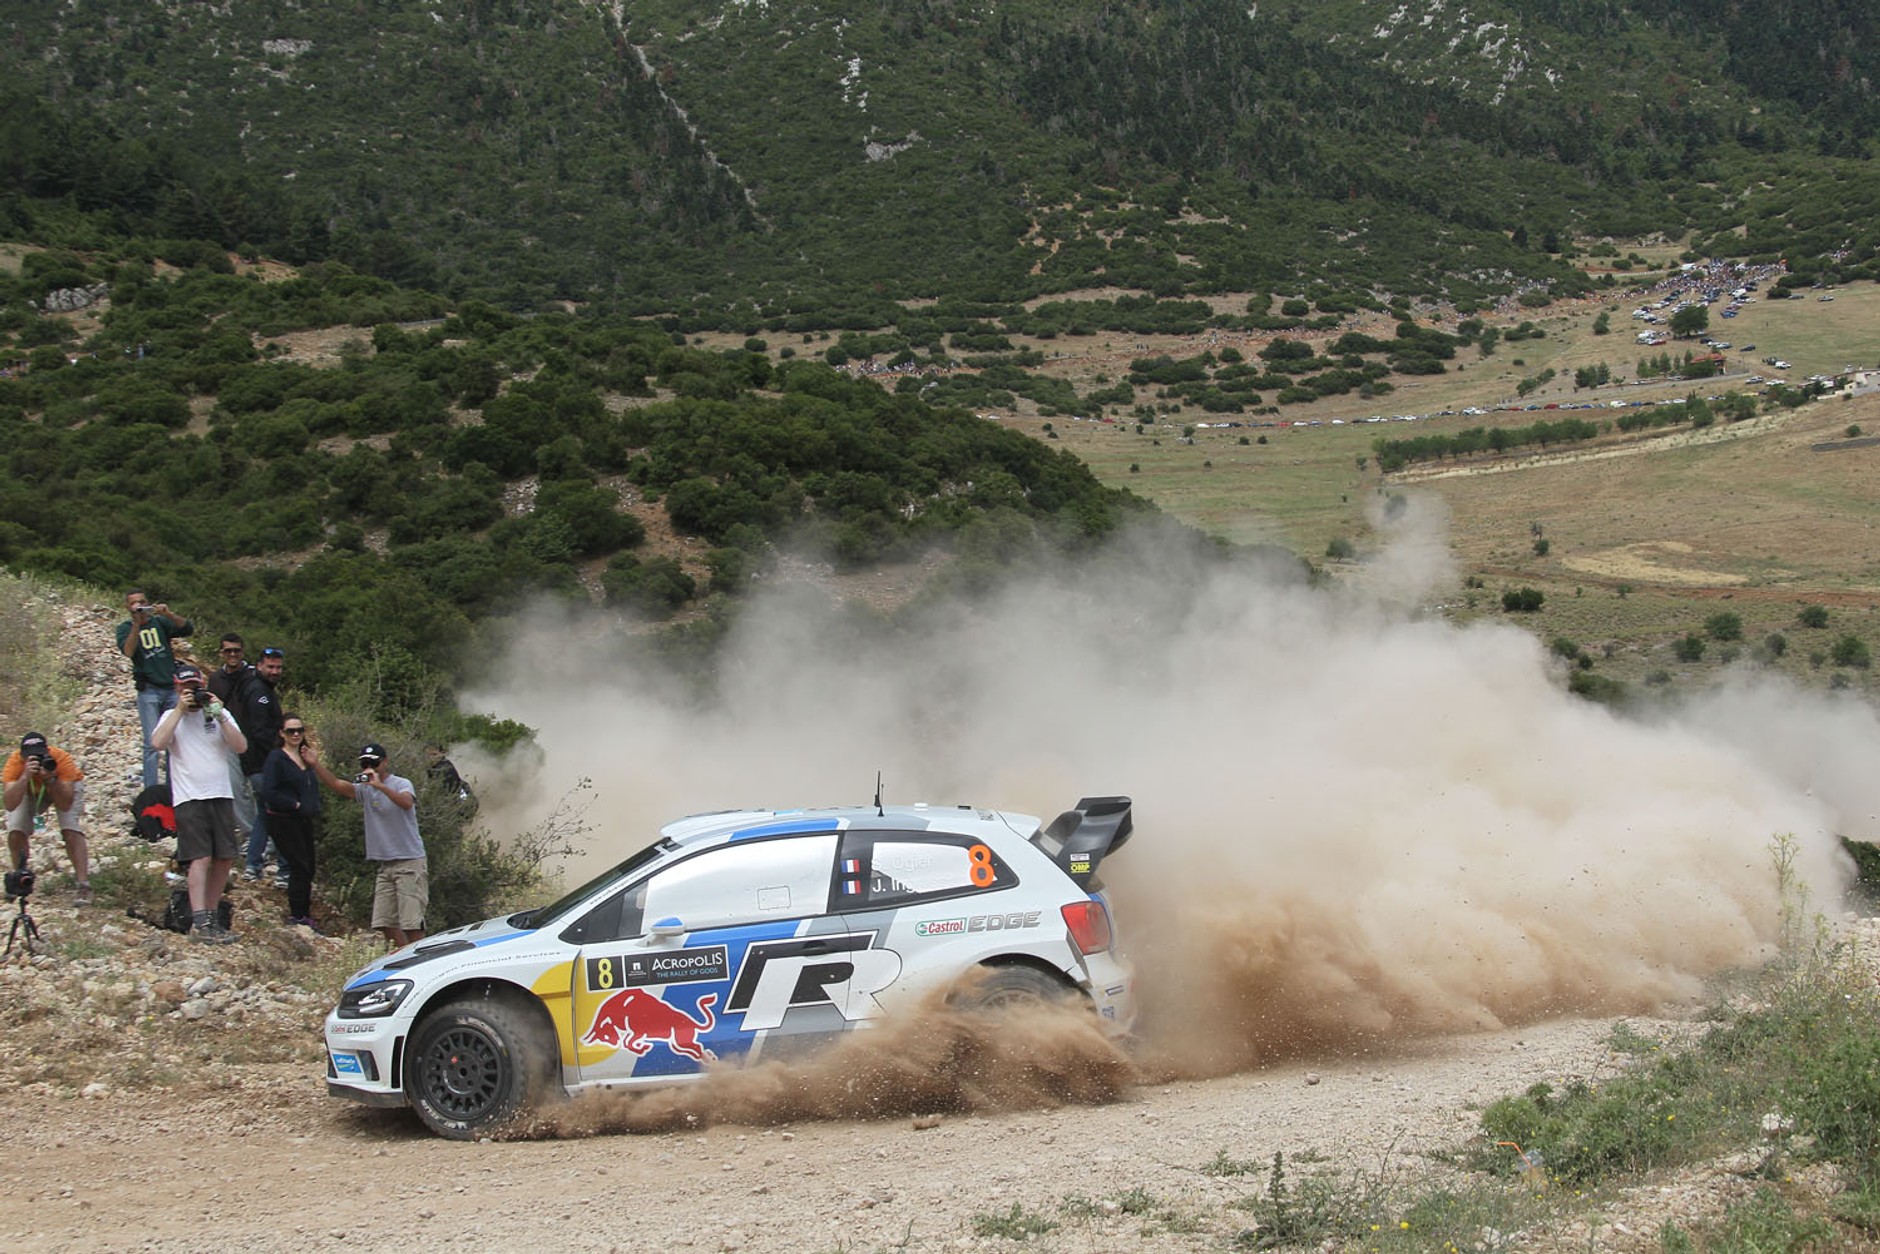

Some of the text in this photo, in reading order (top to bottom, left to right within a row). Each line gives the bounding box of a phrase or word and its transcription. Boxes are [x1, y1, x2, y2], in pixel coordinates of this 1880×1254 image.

[139, 627, 161, 649] 01
[968, 844, 995, 888] 8
[1071, 863, 1090, 872] OMP
[928, 911, 1042, 934] Castrol EDGE
[651, 951, 724, 971] ACROPOLIS
[699, 967, 718, 975] GODS
[598, 957, 613, 989] 8
[722, 930, 904, 1031] R
[347, 1022, 377, 1034] EDGE
